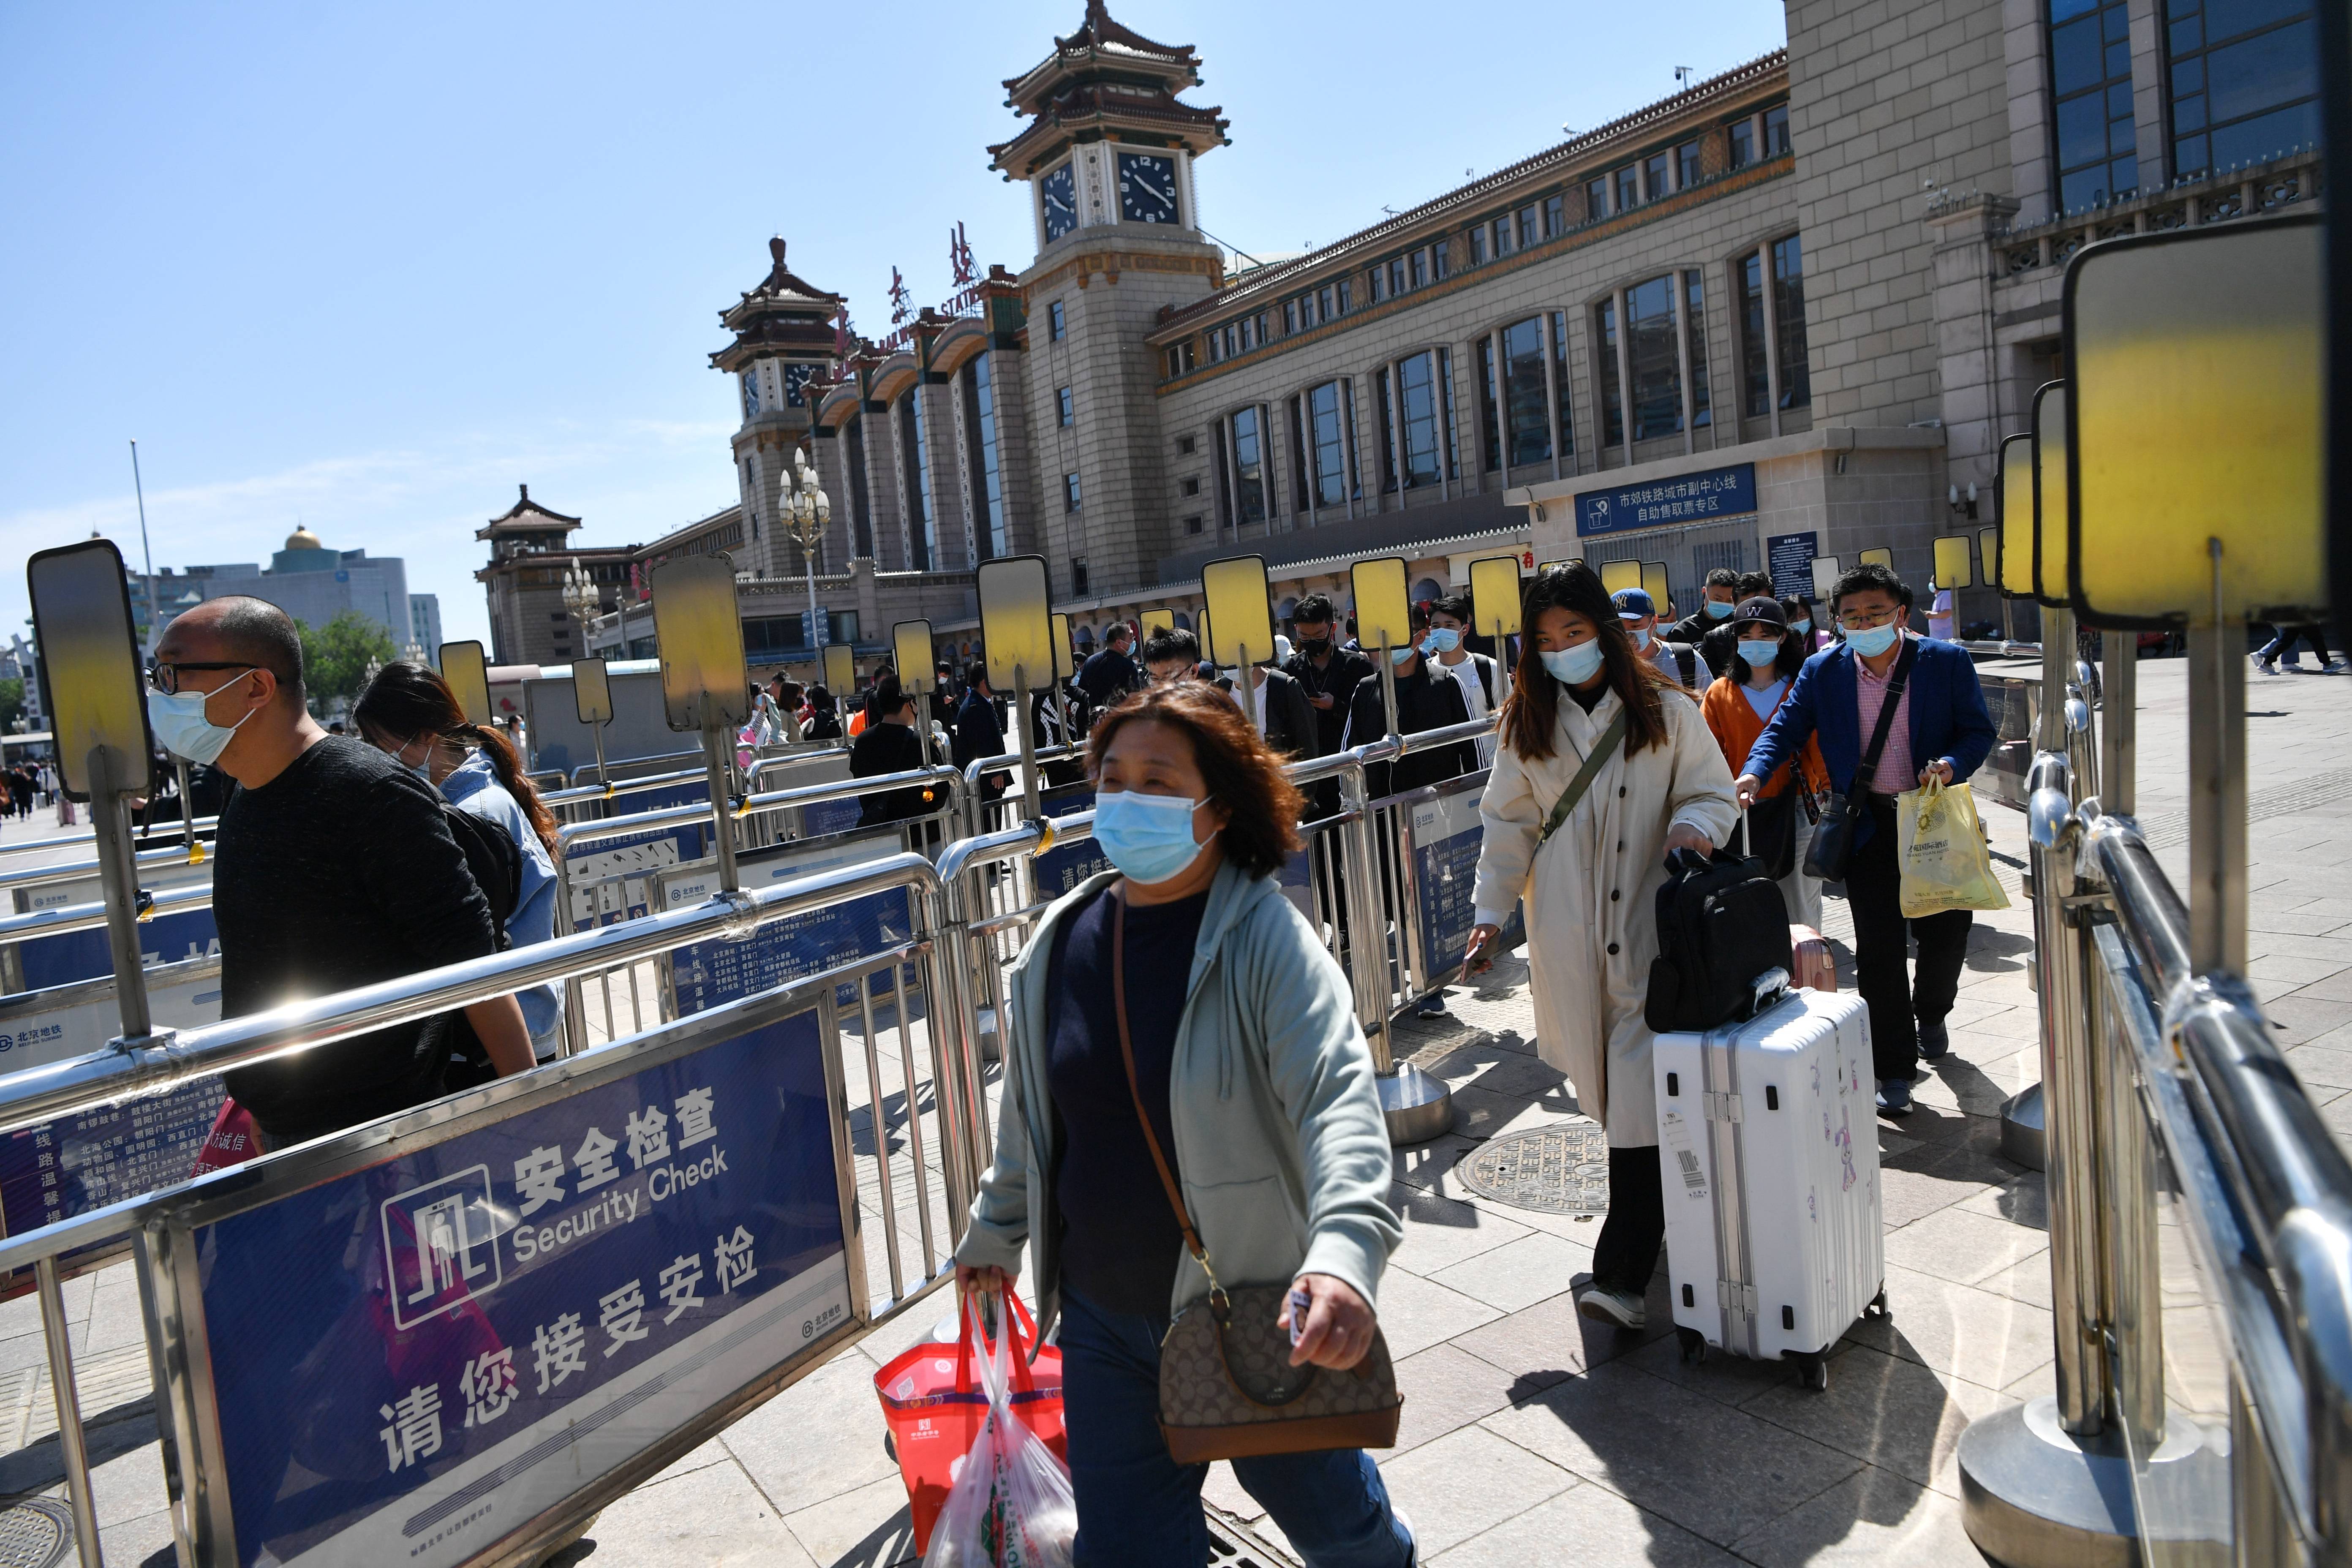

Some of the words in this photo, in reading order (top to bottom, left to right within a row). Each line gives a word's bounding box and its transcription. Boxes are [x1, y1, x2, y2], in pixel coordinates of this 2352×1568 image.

[1140, 156, 1151, 166] 12
[1120, 183, 1130, 192] 9
[1166, 187, 1175, 197] 3
[1146, 214, 1155, 223] 6
[1619, 474, 1737, 508] 市郊铁路城市副中心线
[1638, 496, 1719, 523] 自助售取票专区
[1615, 594, 1627, 609] NY
[1745, 607, 1764, 617] W
[683, 885, 705, 895] 北京地铁
[774, 933, 795, 943] 北京南站
[17, 1024, 62, 1042] 北京地铁
[18, 1040, 39, 1048] BEIJING
[41, 1034, 63, 1043] SUBWAY
[133, 1112, 163, 1127] 朝阳门
[514, 1086, 718, 1218] 安全检查
[512, 1182, 640, 1263] Security
[649, 1145, 729, 1201] Check
[815, 1303, 841, 1326] 北京地铁
[380, 1225, 758, 1474] 请您接受安检
